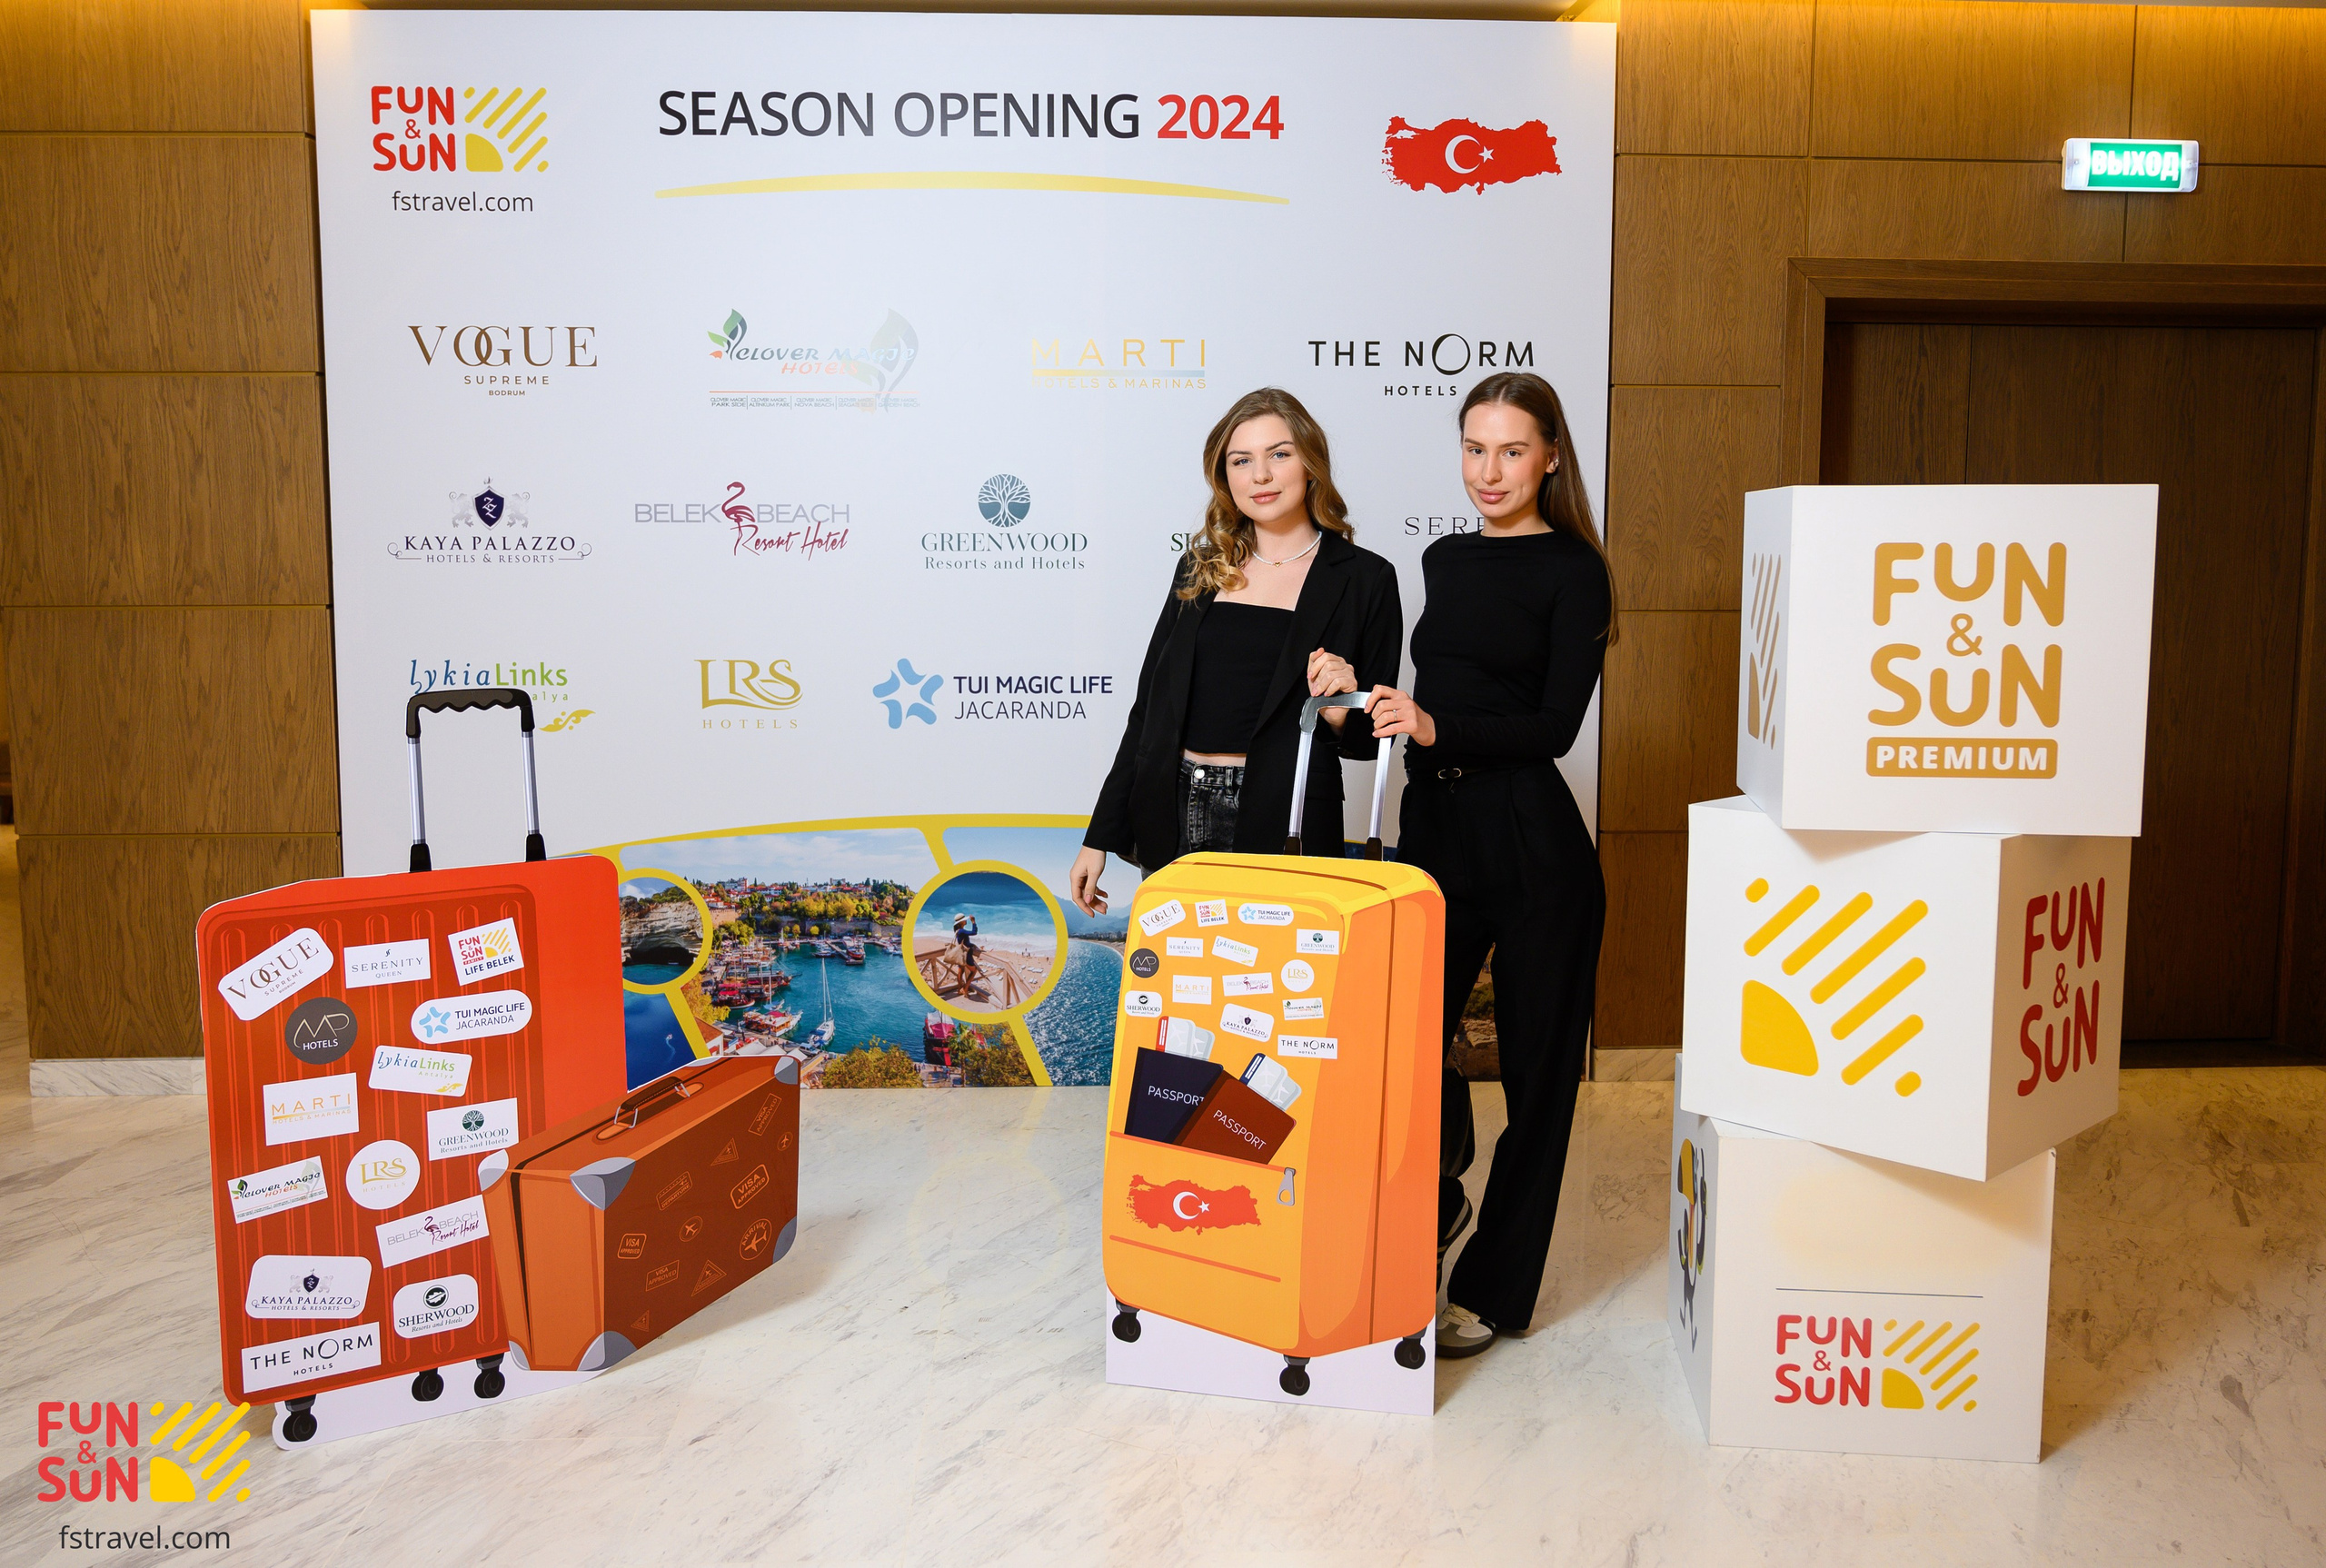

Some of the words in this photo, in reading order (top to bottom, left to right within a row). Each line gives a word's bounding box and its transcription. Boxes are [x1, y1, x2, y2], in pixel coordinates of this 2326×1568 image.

[371, 86, 454, 125] FUN
[659, 90, 873, 138] SEASON
[894, 92, 1140, 139] OPENING
[1158, 94, 1284, 140] 2024
[405, 119, 422, 139] &
[373, 133, 456, 172] SUN
[2092, 150, 2179, 181] ВЫХОД
[392, 191, 533, 213] fstravel.com
[408, 325, 597, 367] VOGUE
[736, 348, 819, 361] CLOVER
[828, 348, 915, 361] MAGIC
[1032, 338, 1205, 367] MARTI
[1308, 341, 1380, 366] THE
[1405, 333, 1534, 375] NORM
[781, 362, 858, 375] HOTELS
[463, 374, 550, 385] SUPREME
[1032, 378, 1099, 388] HOTELS
[1108, 379, 1118, 388] &
[1125, 379, 1207, 389] MARINAS
[1385, 385, 1457, 396] HOTELS
[635, 504, 721, 523] BELEK
[757, 504, 850, 523] BEACH
[404, 536, 463, 551] KAYA
[472, 536, 576, 551] PALAZZO
[731, 524, 800, 556] Resort
[800, 521, 849, 561] Hotel
[920, 532, 1088, 552] GREENWOOD
[426, 555, 476, 563] HOTELS
[482, 554, 492, 563] &
[499, 555, 555, 563] RESORTS
[925, 557, 987, 570] Resorts
[993, 557, 1025, 570] and
[1032, 557, 1085, 570] Hotels
[1872, 541, 2067, 627] FUN
[1946, 613, 1983, 657] &
[694, 659, 804, 710] LRS
[953, 676, 989, 694] TUI
[996, 676, 1063, 694] MAGIC
[1070, 676, 1113, 694] LIFE
[1867, 643, 2063, 728] SUN
[954, 701, 1087, 719] JACARANDA
[702, 719, 798, 729] HOTELS
[1875, 745, 2048, 771] PREMIUM
[1142, 904, 1180, 927] VOGUE
[458, 936, 481, 949] FUN
[2023, 877, 2105, 990] FUN
[226, 938, 319, 999] VOGUE
[352, 958, 423, 973] SERENITY
[375, 970, 403, 978] QUEEN
[465, 966, 484, 976] LIFE
[486, 955, 515, 969] BELEK
[1287, 968, 1308, 979] LRS
[264, 969, 303, 996] SUPREME
[2053, 962, 2070, 1009] &
[455, 1009, 472, 1019] TUI
[473, 1005, 504, 1017] MAGIC
[506, 1002, 525, 1013] LIFE
[456, 1015, 514, 1030] JACARANDA
[1241, 1025, 1266, 1036] PALAZZO
[303, 1038, 339, 1051] HOTELS
[1281, 1039, 1298, 1047] THE
[1303, 1040, 1335, 1050] NORM
[2017, 979, 2100, 1097] SUN
[419, 1071, 454, 1079] Antalya
[272, 1093, 351, 1116] MARTI
[756, 1106, 768, 1122] VISA
[756, 1097, 778, 1132] APPROVED
[273, 1116, 303, 1125] HOTELS
[314, 1109, 352, 1119] MARINAS
[438, 1127, 509, 1146] GREENWOOD
[1213, 1109, 1267, 1150] PASSPORT
[440, 1145, 467, 1154] Resorts
[485, 1137, 508, 1146] Hotels
[359, 1157, 407, 1185] LRS
[244, 1184, 281, 1198] CLOVER
[283, 1172, 321, 1187] MAGIC
[363, 1182, 406, 1193] HOTELS
[738, 1174, 760, 1194] VISA
[738, 1177, 766, 1204] APPROVED
[661, 1185, 690, 1208] DEPARTURE
[387, 1227, 425, 1245] BELEK
[438, 1210, 479, 1229] BEACH
[460, 1219, 479, 1236] Hotel
[741, 1221, 768, 1246] ARRIVAL
[625, 1238, 640, 1247] VISA
[648, 1269, 676, 1285] APPROVED
[656, 1266, 669, 1275] VISA
[262, 1296, 293, 1305] KAYA
[297, 1296, 353, 1305] PALAZZO
[399, 1304, 474, 1328] SHERWOOD
[411, 1323, 432, 1332] Resorts
[432, 1320, 443, 1328] and
[445, 1316, 462, 1326] Hotels
[1775, 1315, 1872, 1359] FUN
[250, 1350, 291, 1370] THE
[303, 1334, 373, 1361] NORM
[1813, 1349, 1832, 1372] &
[293, 1363, 333, 1376] HOTELS
[1774, 1363, 1871, 1407] SUN
